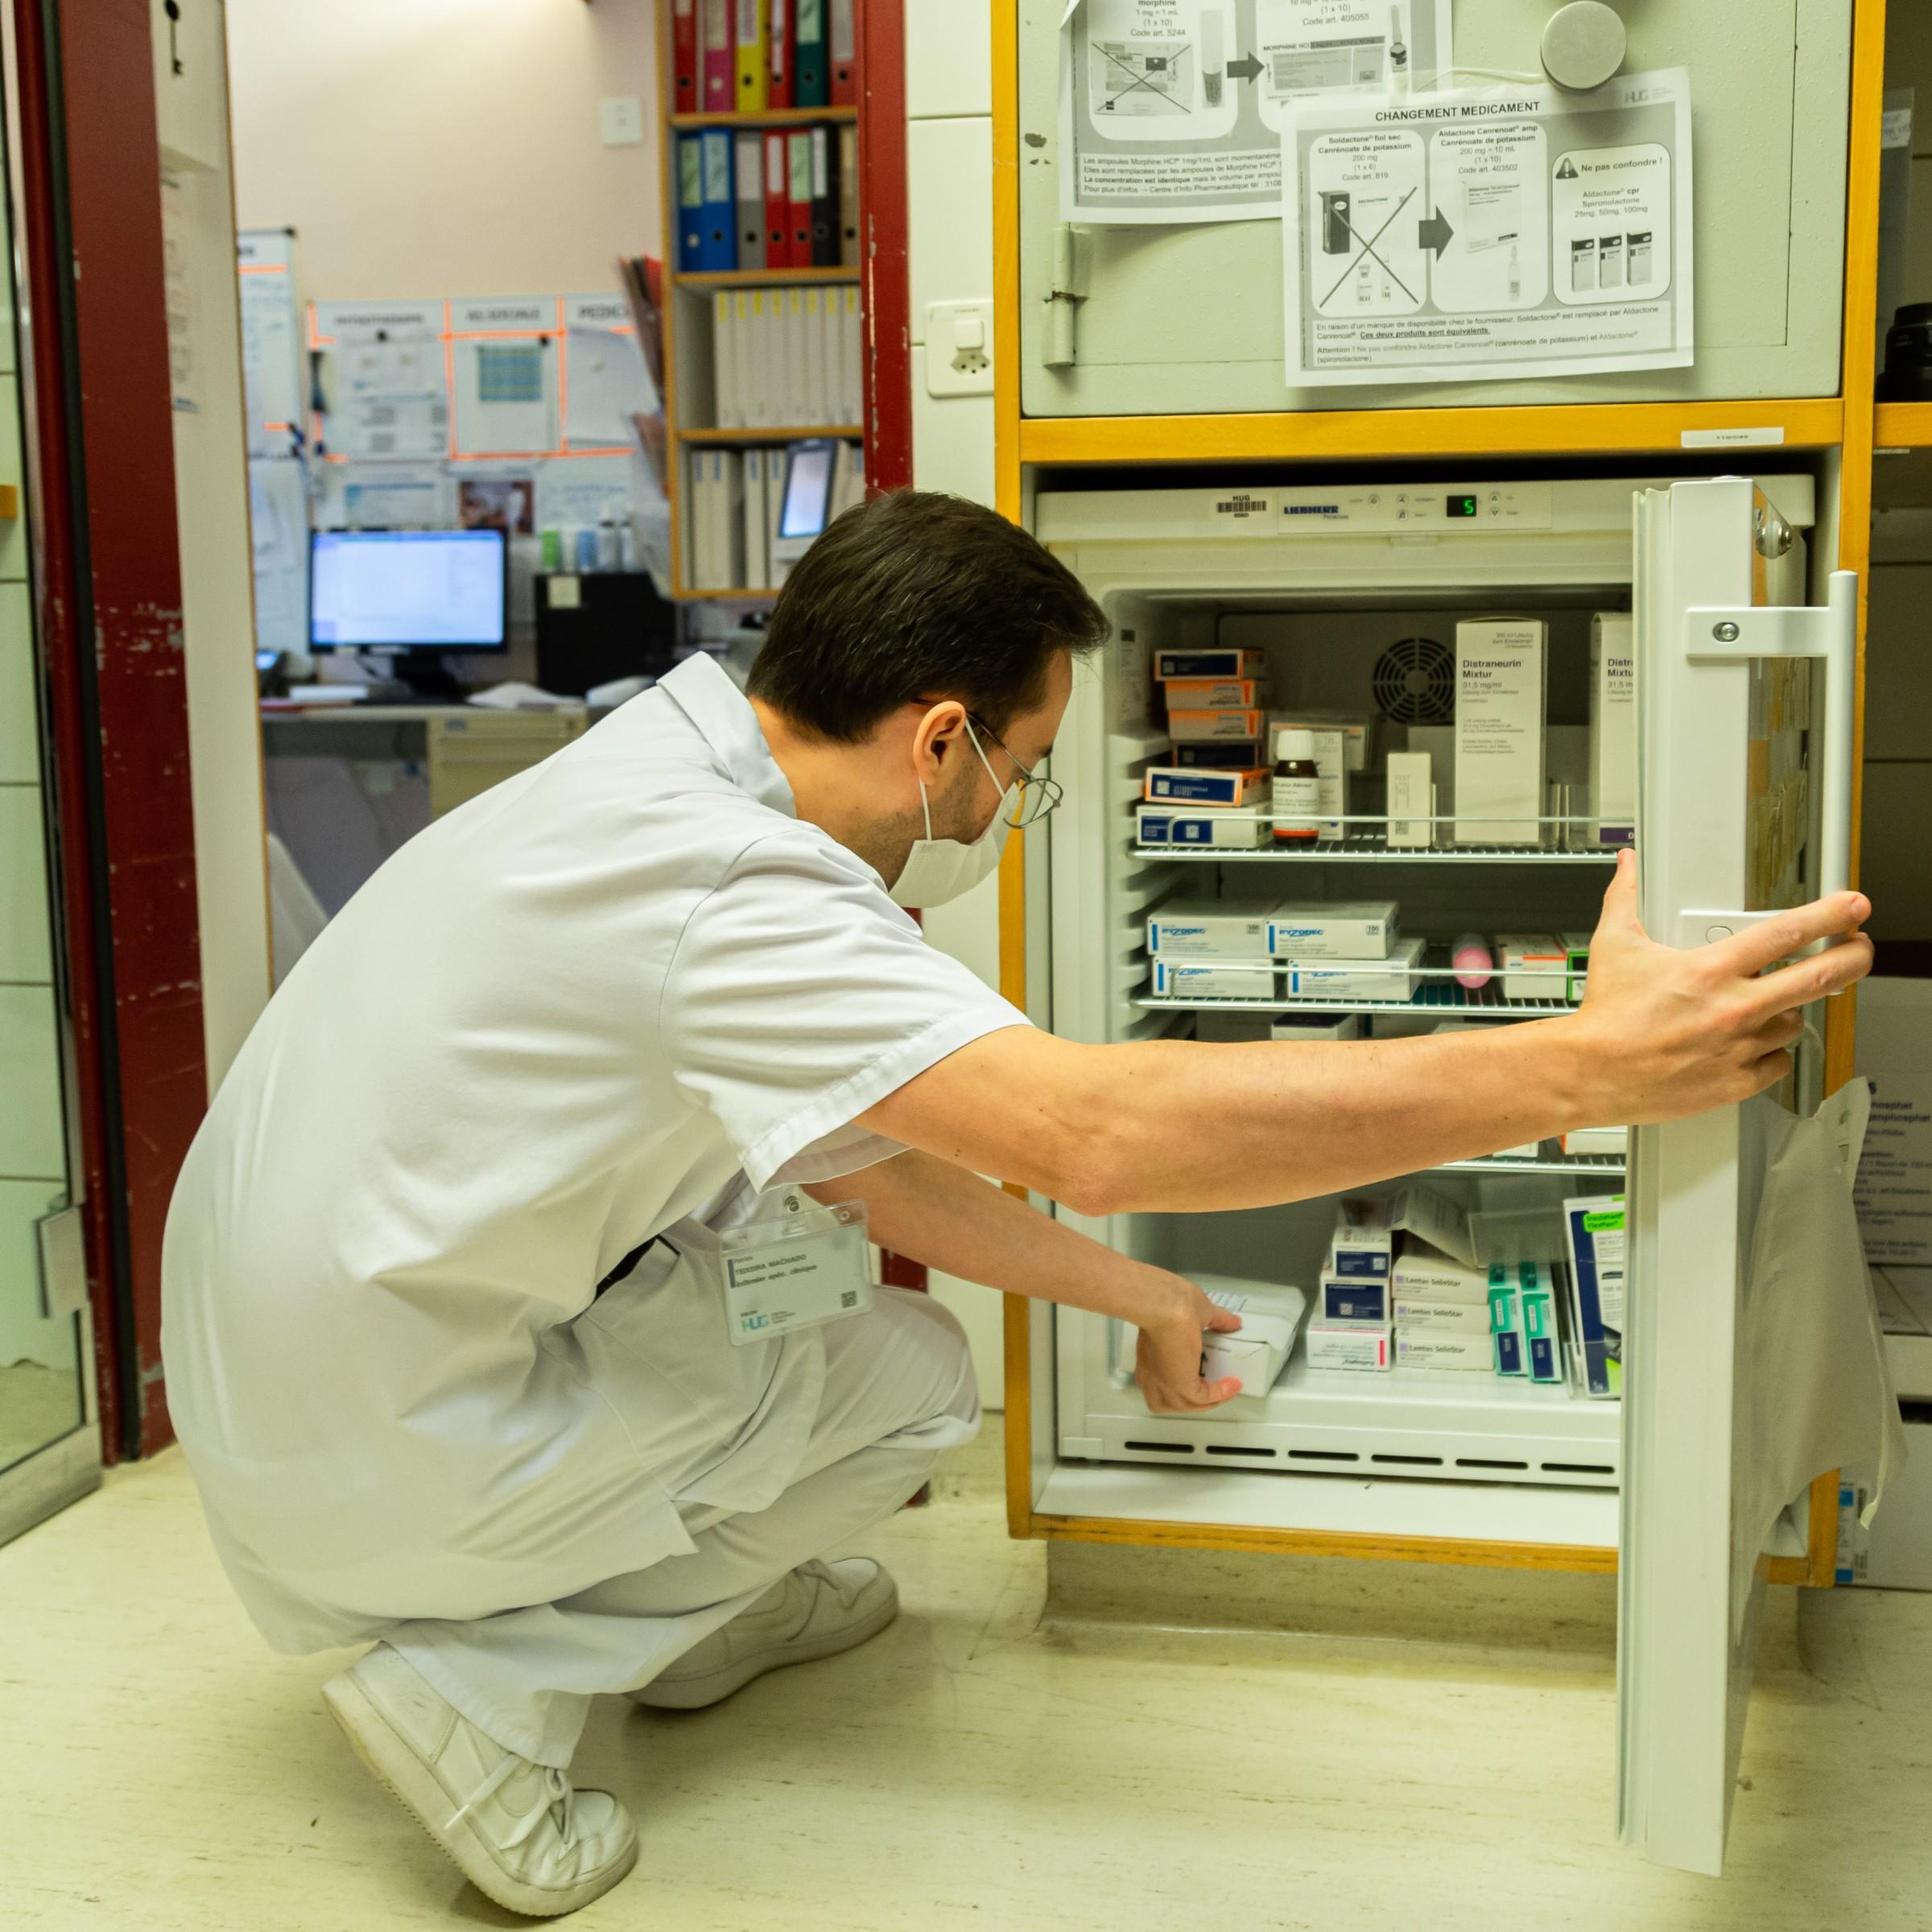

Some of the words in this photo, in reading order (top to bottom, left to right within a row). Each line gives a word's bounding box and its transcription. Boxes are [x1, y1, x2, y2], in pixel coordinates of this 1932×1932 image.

[1625, 89, 1649, 103] HUG
[1375, 107, 1458, 122] CHANGEMENT
[1461, 101, 1540, 117] MEDICAMENT
[1521, 125, 1538, 133] amp
[1496, 134, 1536, 144] potassium
[1373, 142, 1412, 152] potassium
[1475, 157, 1482, 165] (1
[1490, 155, 1502, 163] 10)
[1182, 166, 1214, 174] ampoules
[1226, 163, 1257, 171] Morphine
[1492, 163, 1519, 171] 403502
[1581, 164, 1592, 172] Ne
[1595, 163, 1611, 172] pas
[1612, 159, 1657, 170] confondre
[1095, 176, 1143, 184] concentration
[1158, 175, 1191, 185] identique
[1218, 173, 1243, 181] volume
[1245, 173, 1256, 181] par
[1375, 171, 1389, 180] 819
[1101, 185, 1116, 193] plus
[1117, 184, 1138, 192] d'infos
[1150, 185, 1172, 193] Centre
[1194, 182, 1249, 192] Pharmaceutique
[1627, 187, 1640, 196] cpr
[1582, 197, 1641, 208] Spironolactone
[1624, 205, 1649, 214] 100mg
[1367, 322, 1395, 330] manque
[1407, 320, 1447, 328] disponibilité
[1575, 309, 1608, 320] remplacé
[1610, 310, 1621, 318] par
[1623, 306, 1658, 316] Aldactone
[1360, 330, 1373, 339] Ces
[1376, 330, 1394, 338] deux
[1396, 328, 1426, 338] produits
[1428, 328, 1444, 336] sont
[1447, 327, 1491, 337] équivalents.
[1368, 345, 1381, 353] pas
[1383, 344, 1417, 353] confondre
[1418, 342, 1453, 350] Aldactone
[1538, 336, 1548, 345] de
[1550, 334, 1589, 345] potassium)
[1591, 333, 1599, 341] et
[1284, 506, 1339, 514] LIEBHERR
[1464, 499, 1474, 514] 5
[1462, 670, 1492, 678] Mixtur
[1871, 1101, 1913, 1111] hosphat
[1406, 1277, 1430, 1285] Lantus
[741, 1314, 770, 1332] HUG
